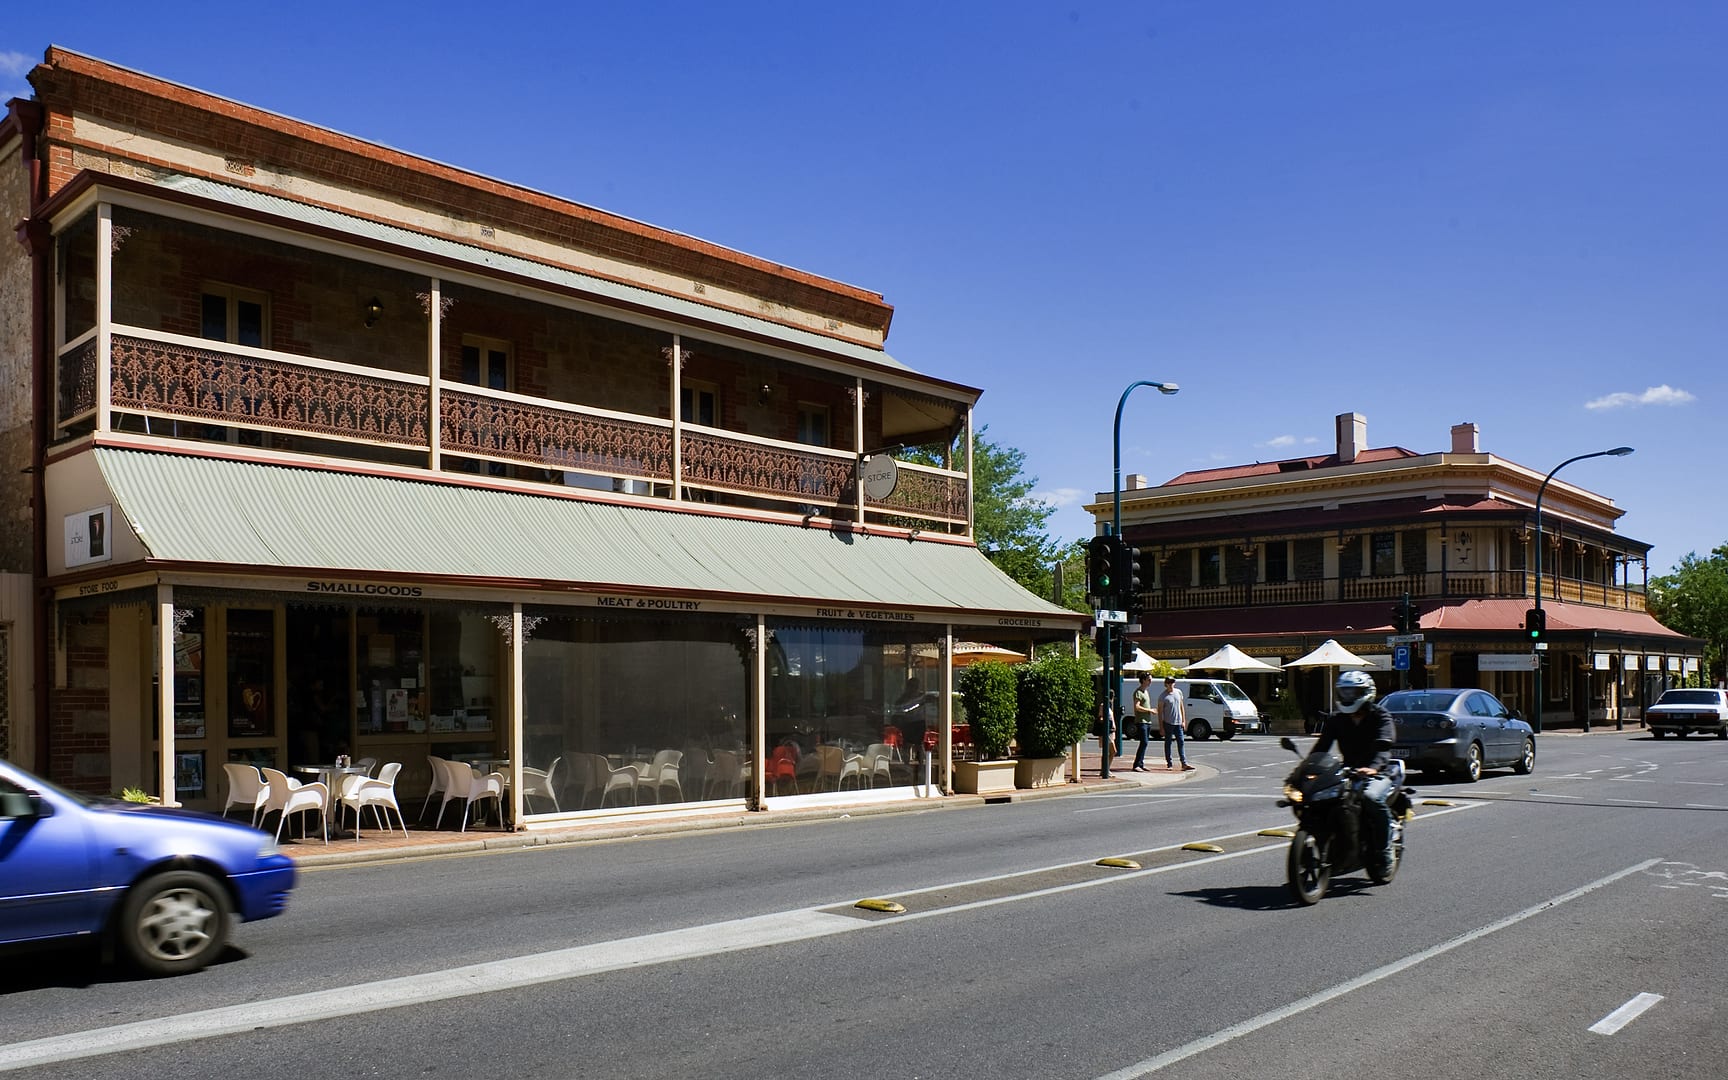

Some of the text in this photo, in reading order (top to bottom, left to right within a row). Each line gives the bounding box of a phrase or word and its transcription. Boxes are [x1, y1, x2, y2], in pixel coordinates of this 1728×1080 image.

[867, 472, 892, 483] STORE
[1454, 531, 1473, 545] LIN
[80, 581, 119, 595] STORE FOOD
[306, 581, 423, 597] SMALLGOODS
[597, 597, 702, 610] MEAT & POULTRY
[816, 608, 916, 621] FRUIT & VEGETABLES
[998, 618, 1041, 627] GROCERIES
[1397, 648, 1407, 660] P
